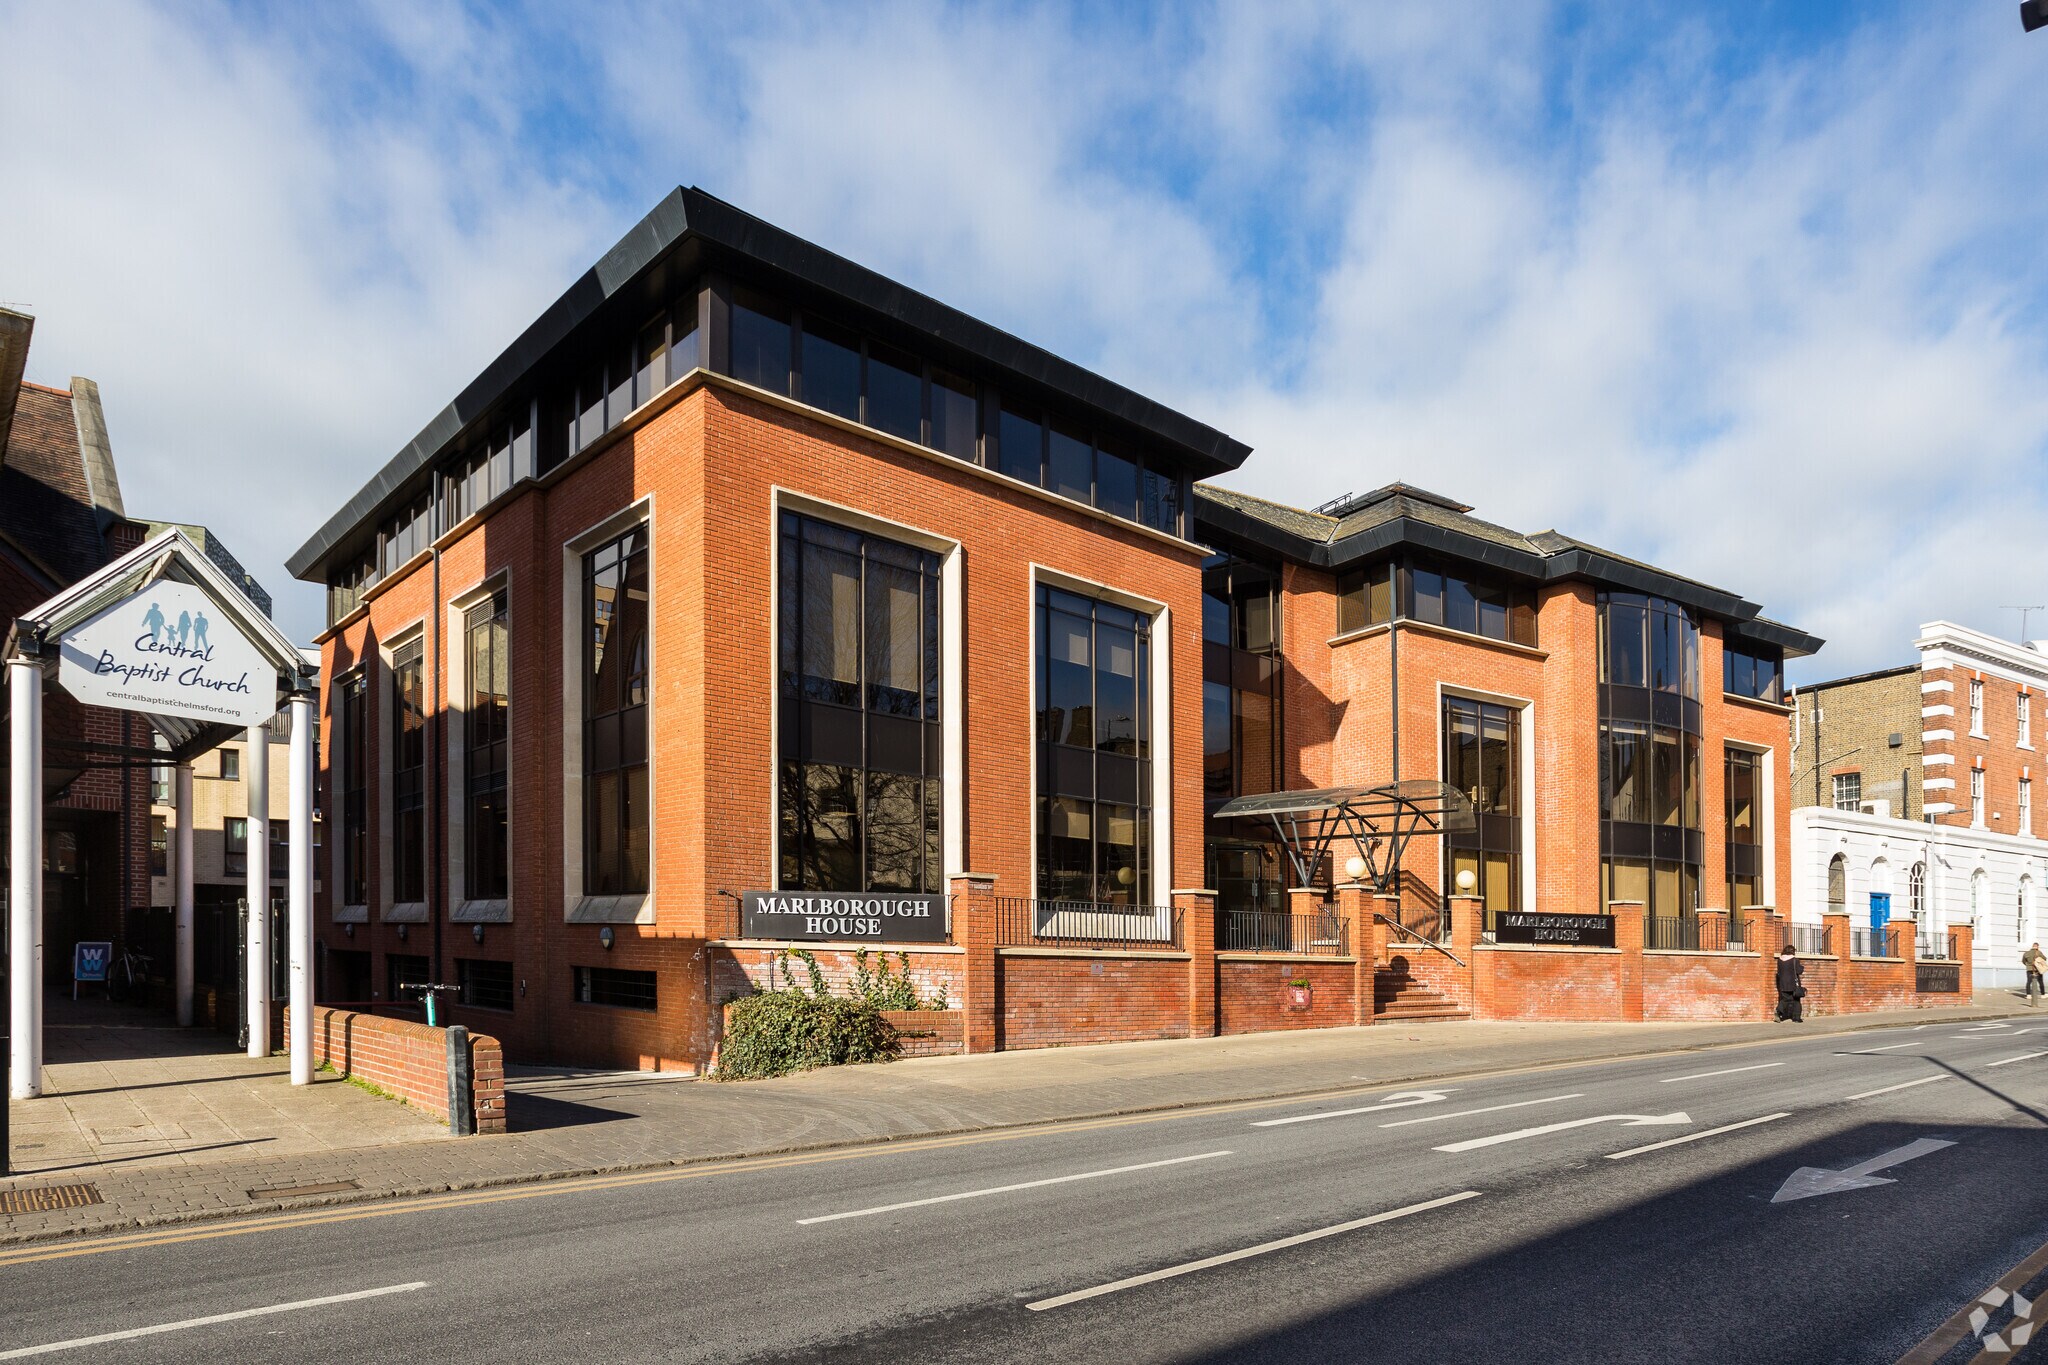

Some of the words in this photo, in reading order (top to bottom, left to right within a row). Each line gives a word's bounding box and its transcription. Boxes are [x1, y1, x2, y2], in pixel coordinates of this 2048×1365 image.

[135, 633, 215, 662] Central
[94, 649, 174, 686] Baptist
[178, 665, 251, 694] Church
[106, 690, 241, 717] centralbaptistchelmsford.org
[756, 897, 930, 917] MARLBOROUGH
[805, 917, 882, 935] HOUSE
[1505, 914, 1608, 930] MARLBOROUGH
[1534, 928, 1580, 941] HOUSE
